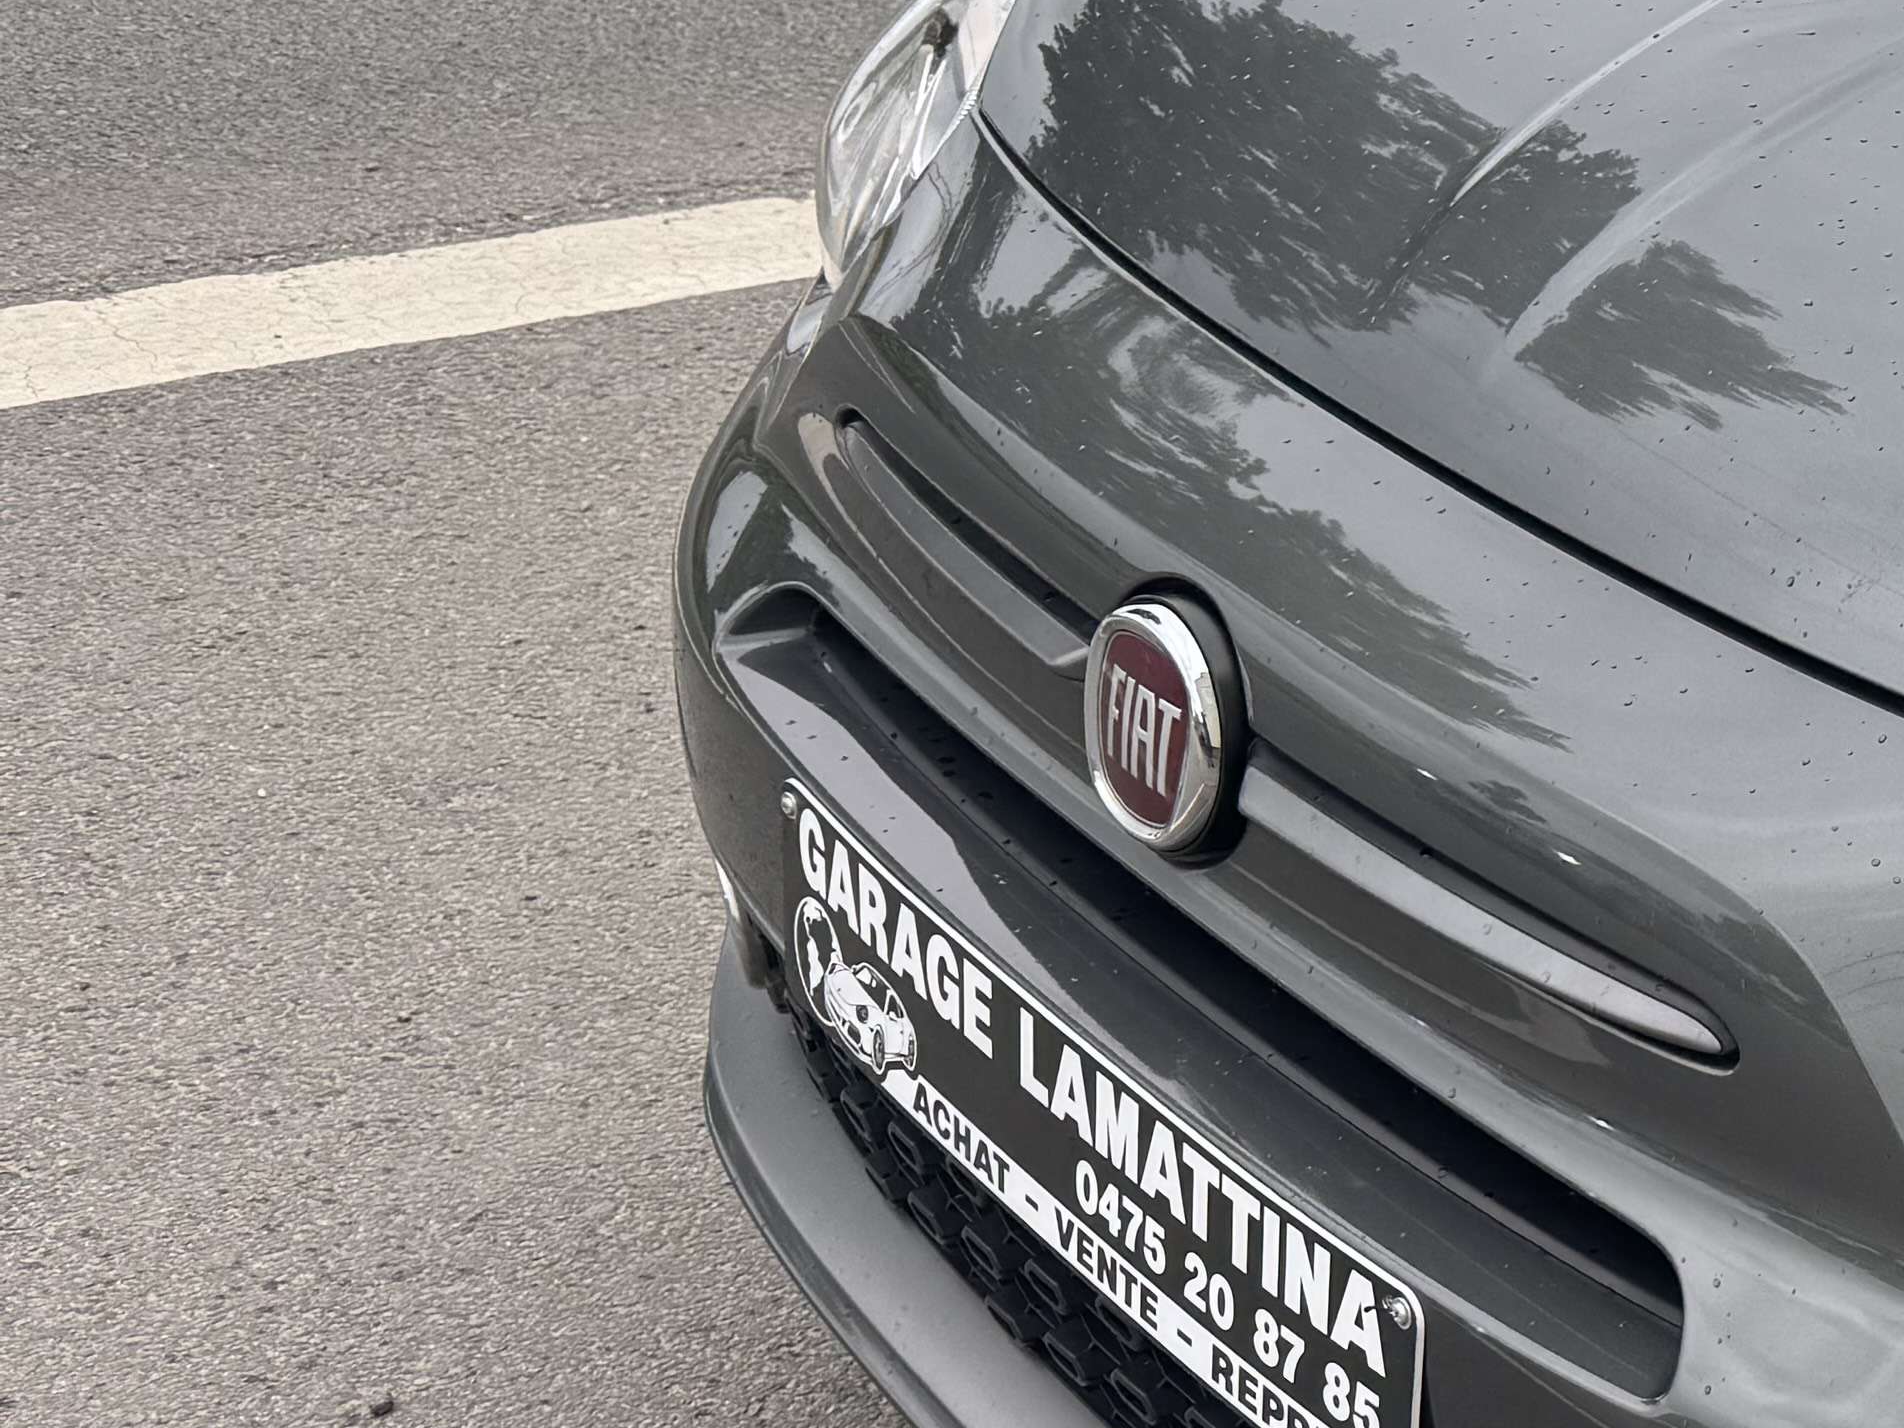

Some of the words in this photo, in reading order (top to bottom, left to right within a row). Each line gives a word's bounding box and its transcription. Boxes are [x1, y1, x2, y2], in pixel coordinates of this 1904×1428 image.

[1107, 664, 1182, 797] FIAT
[798, 807, 993, 1059] GARAGE
[1019, 1005, 1386, 1377] LAMATTINA
[912, 1081, 1010, 1192] ACHAT
[1054, 1209, 1160, 1332] VENTE
[1075, 1158, 1167, 1277] 0475
[1183, 1251, 1235, 1332] 20
[1252, 1309, 1307, 1386] 87
